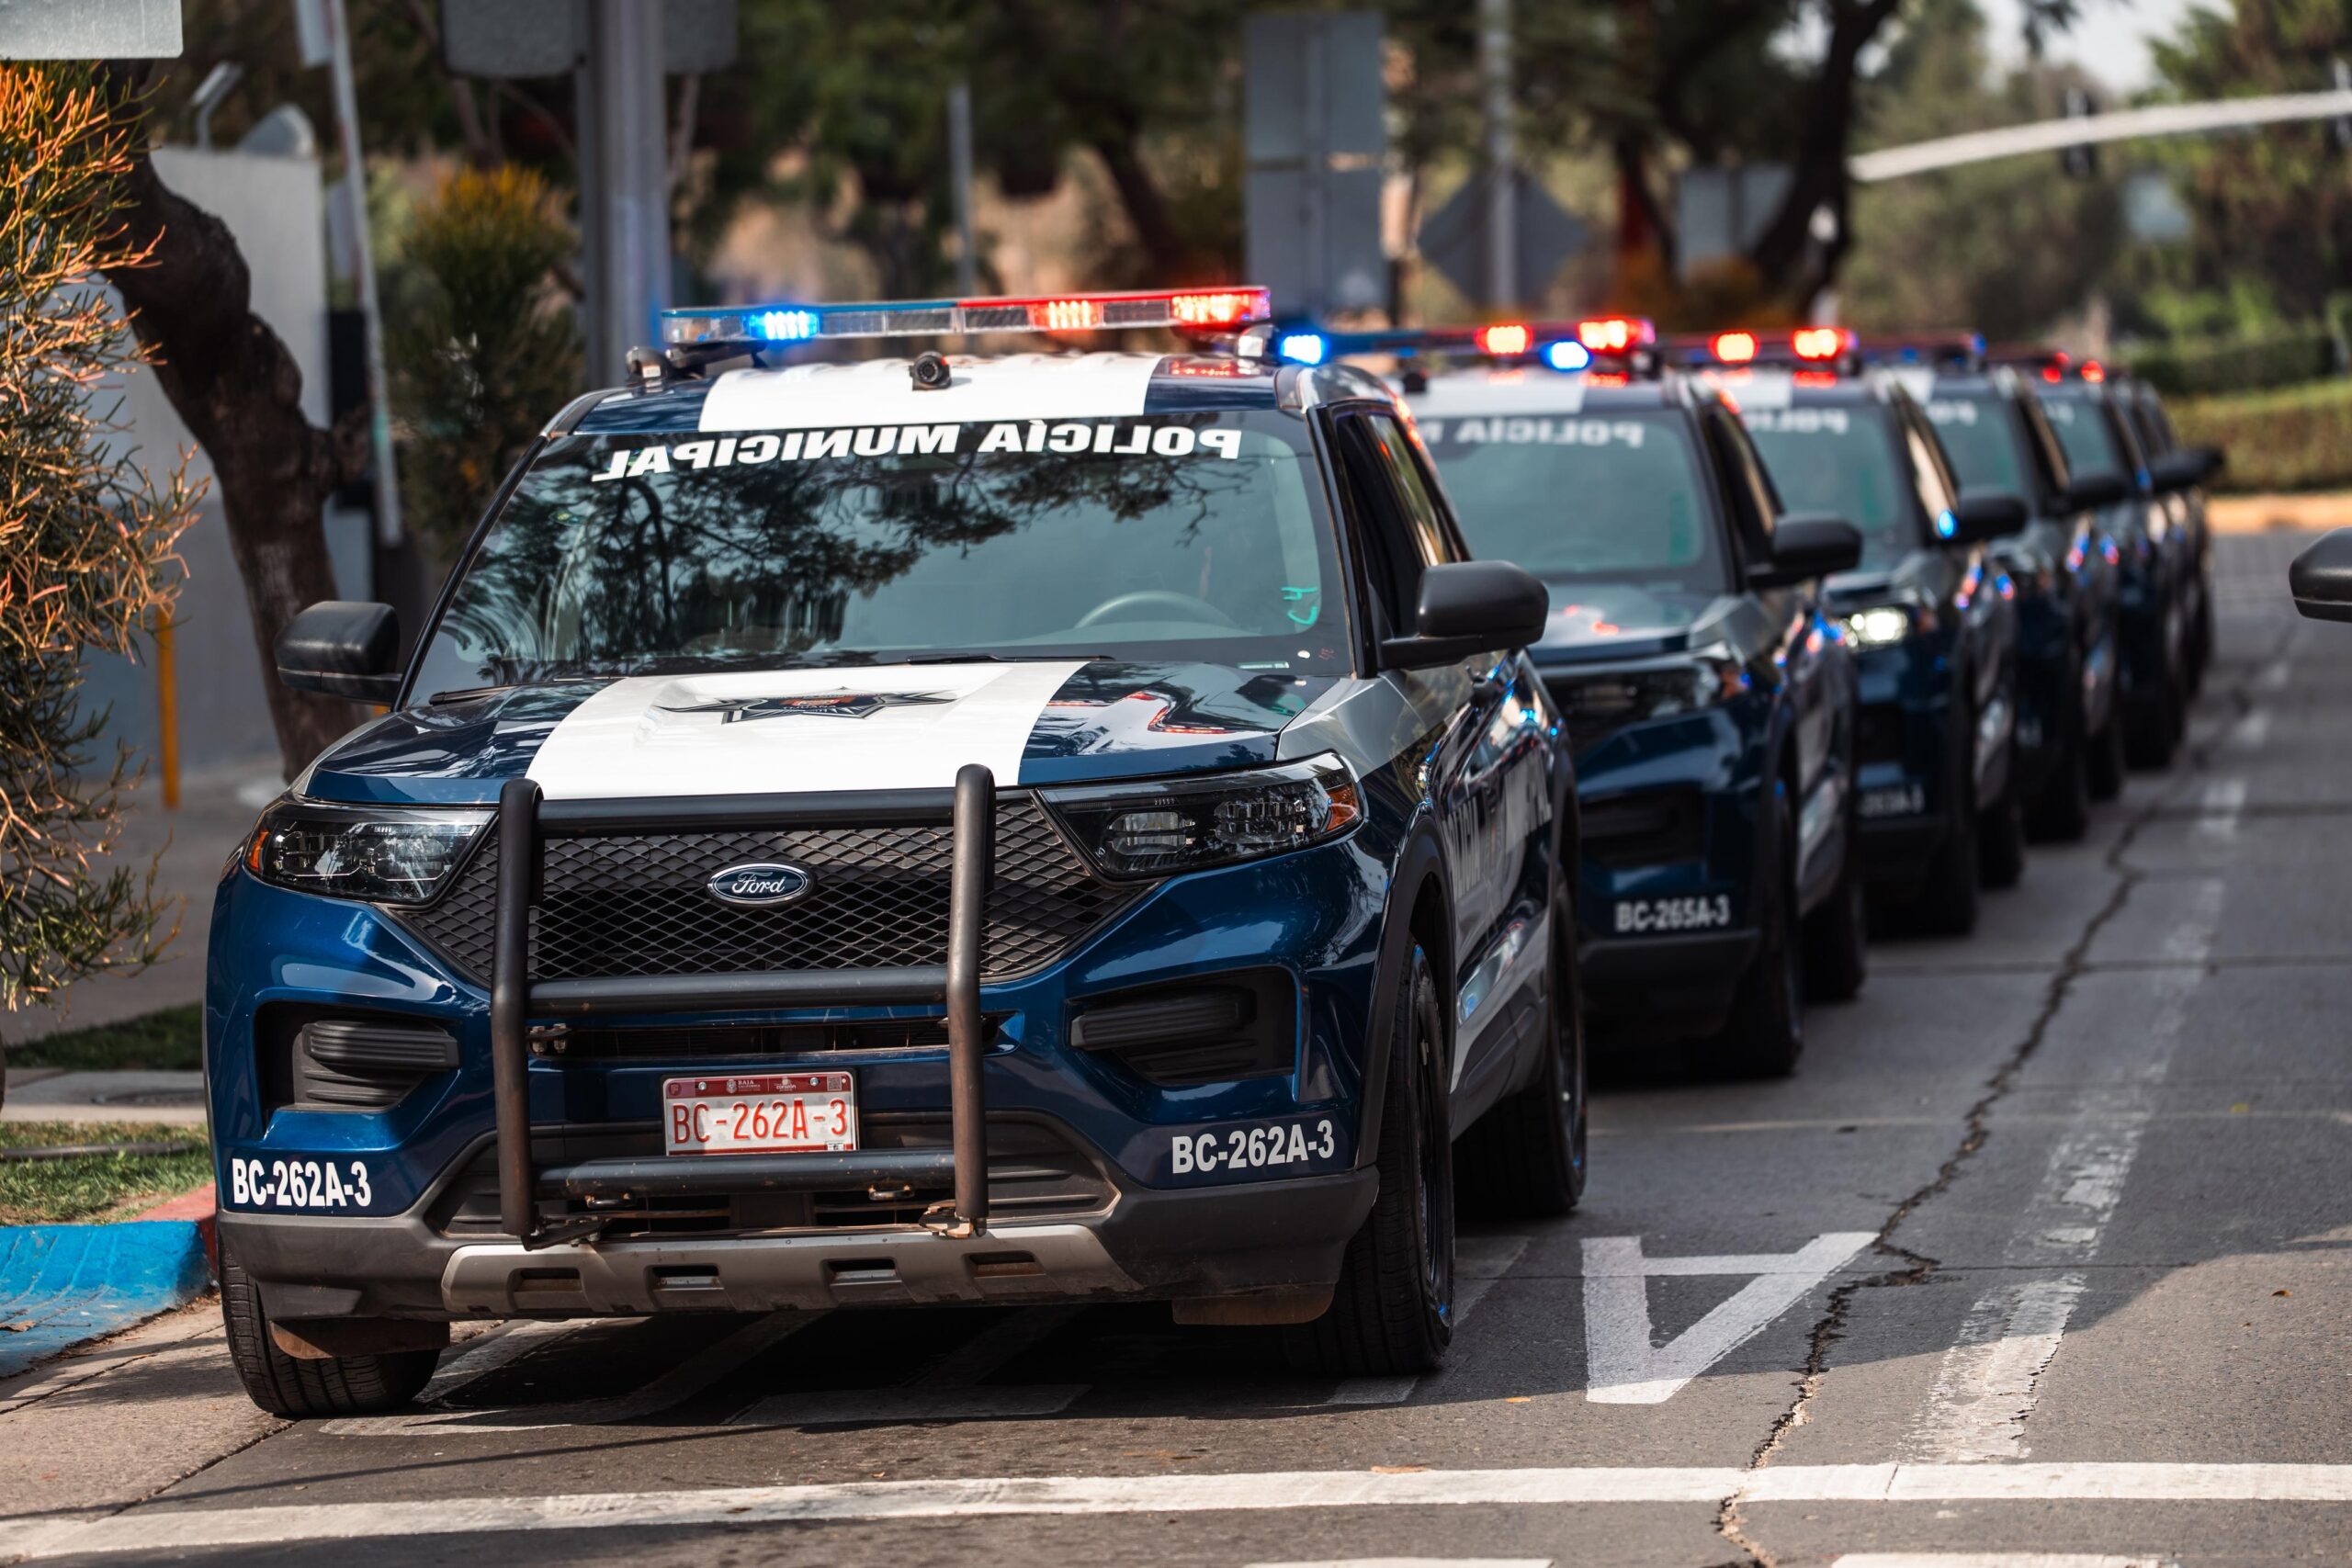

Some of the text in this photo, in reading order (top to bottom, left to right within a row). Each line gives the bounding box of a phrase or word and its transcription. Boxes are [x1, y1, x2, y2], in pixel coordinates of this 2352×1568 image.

[731, 871, 786, 895] Ford
[673, 1098, 847, 1144] BC-262A-3
[1172, 1119, 1335, 1175] BC-262A-3
[232, 1157, 372, 1207] BC-262A-3
